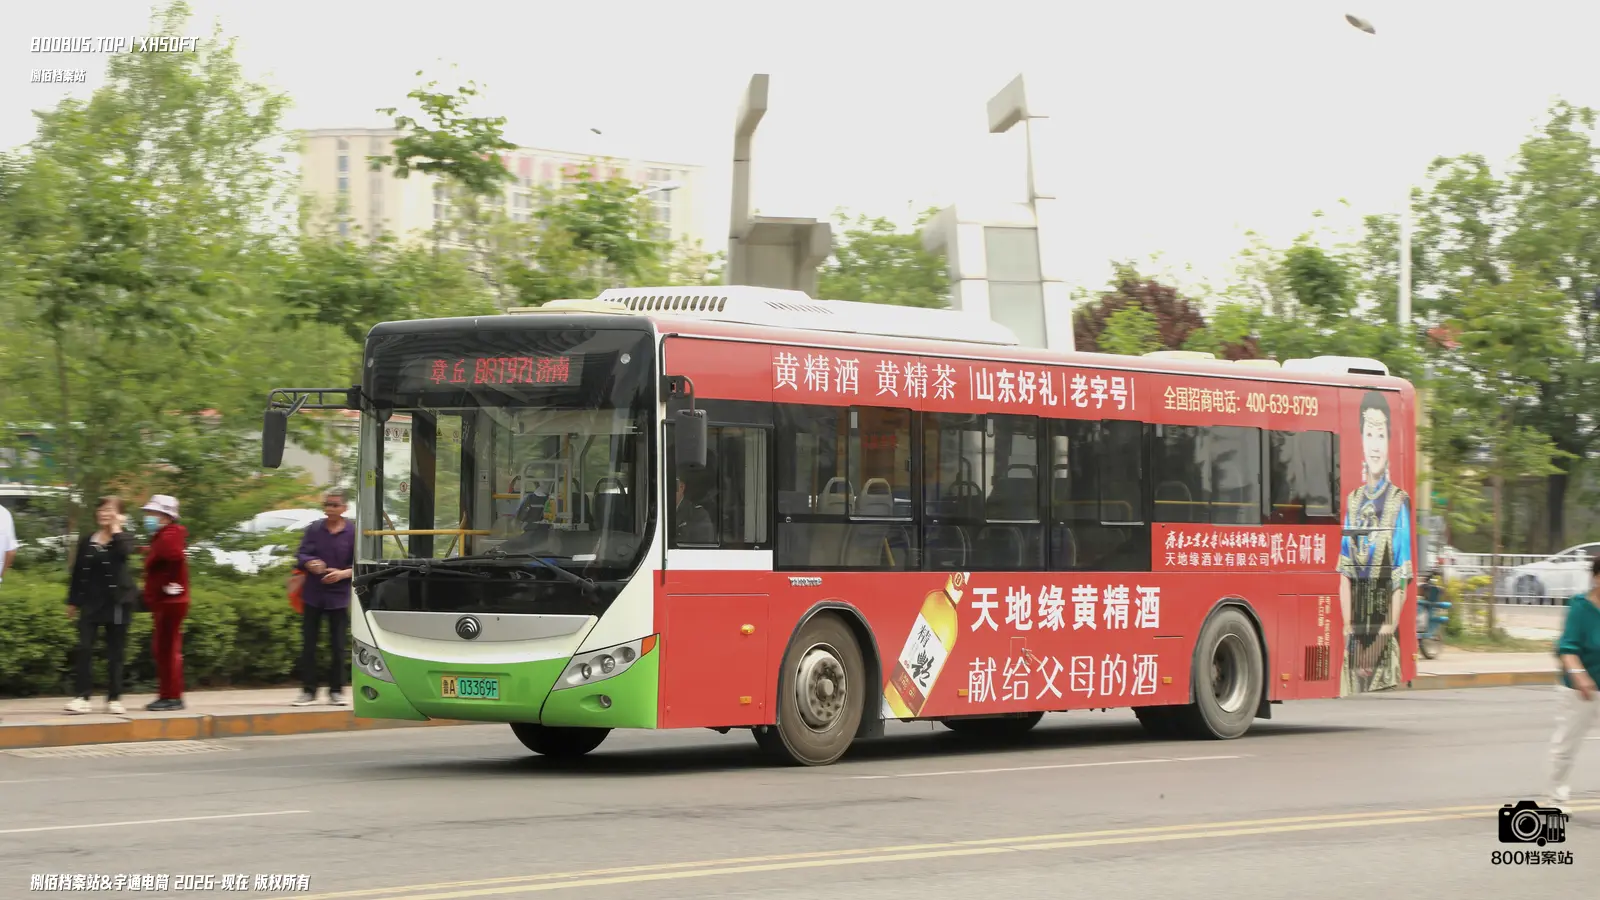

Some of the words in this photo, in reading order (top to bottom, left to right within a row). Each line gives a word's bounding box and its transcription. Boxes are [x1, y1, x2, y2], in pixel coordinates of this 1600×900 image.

[772, 351, 860, 396] 黄精酒
[874, 359, 957, 401] 黄精茶
[1245, 392, 1319, 417] 400-639-8799
[1164, 552, 1270, 567] 天地缘酒业有限公司
[1270, 532, 1327, 566] 联合研制
[970, 583, 1161, 632] 天地缘黄精酒
[460, 679, 498, 697] 03369F
[967, 652, 1160, 704] 献给父母的酒
